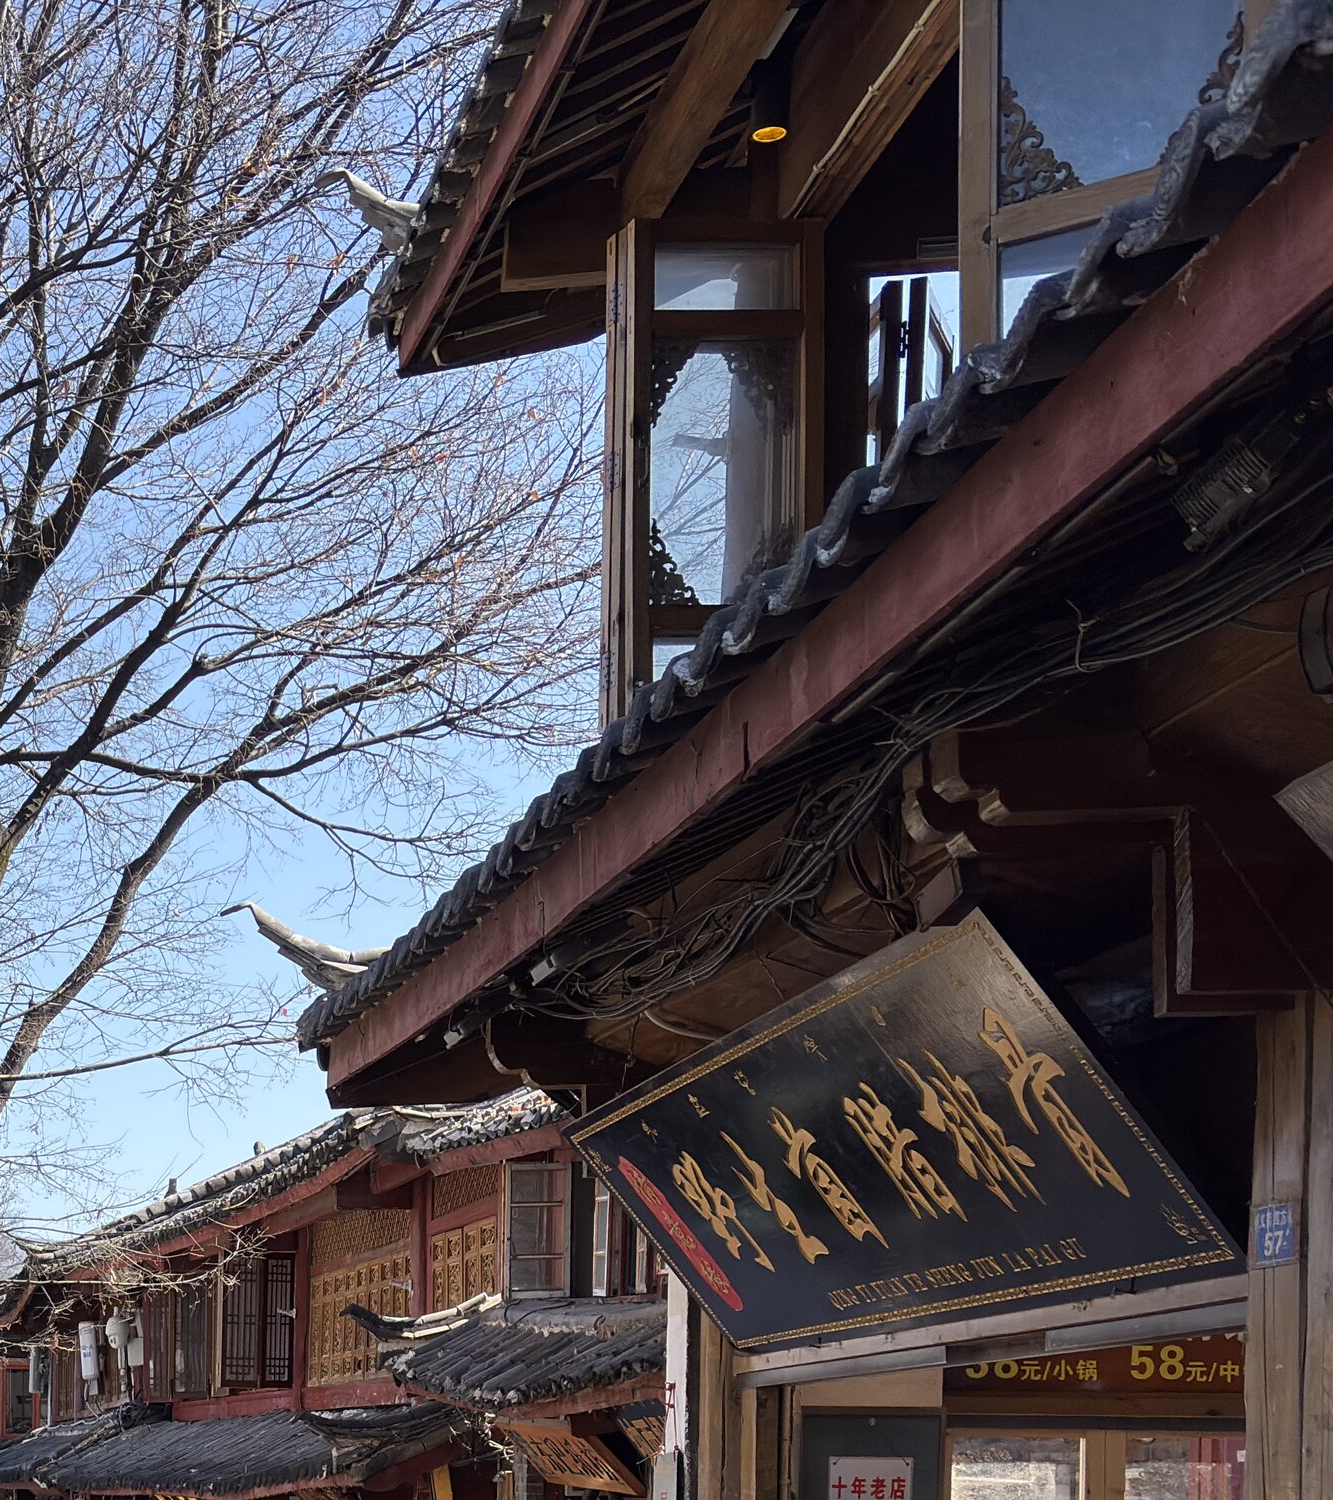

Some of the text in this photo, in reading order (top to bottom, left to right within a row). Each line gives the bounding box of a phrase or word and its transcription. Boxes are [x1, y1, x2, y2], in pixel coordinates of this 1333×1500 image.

[672, 1007, 1131, 1273] 野生菌腊排骨
[1264, 1230, 1284, 1257] 57
[827, 1289, 861, 1311] QING
[855, 1283, 877, 1302] YI
[903, 1272, 929, 1293] YE
[924, 1262, 974, 1288] SHENG
[970, 1255, 1005, 1279] JUN
[1001, 1251, 1032, 1273] LA
[1025, 1243, 1063, 1268] PAI
[1059, 1237, 1088, 1260] GU
[1129, 1344, 1242, 1384] 58元/中
[831, 1476, 907, 1500] 十年老店
